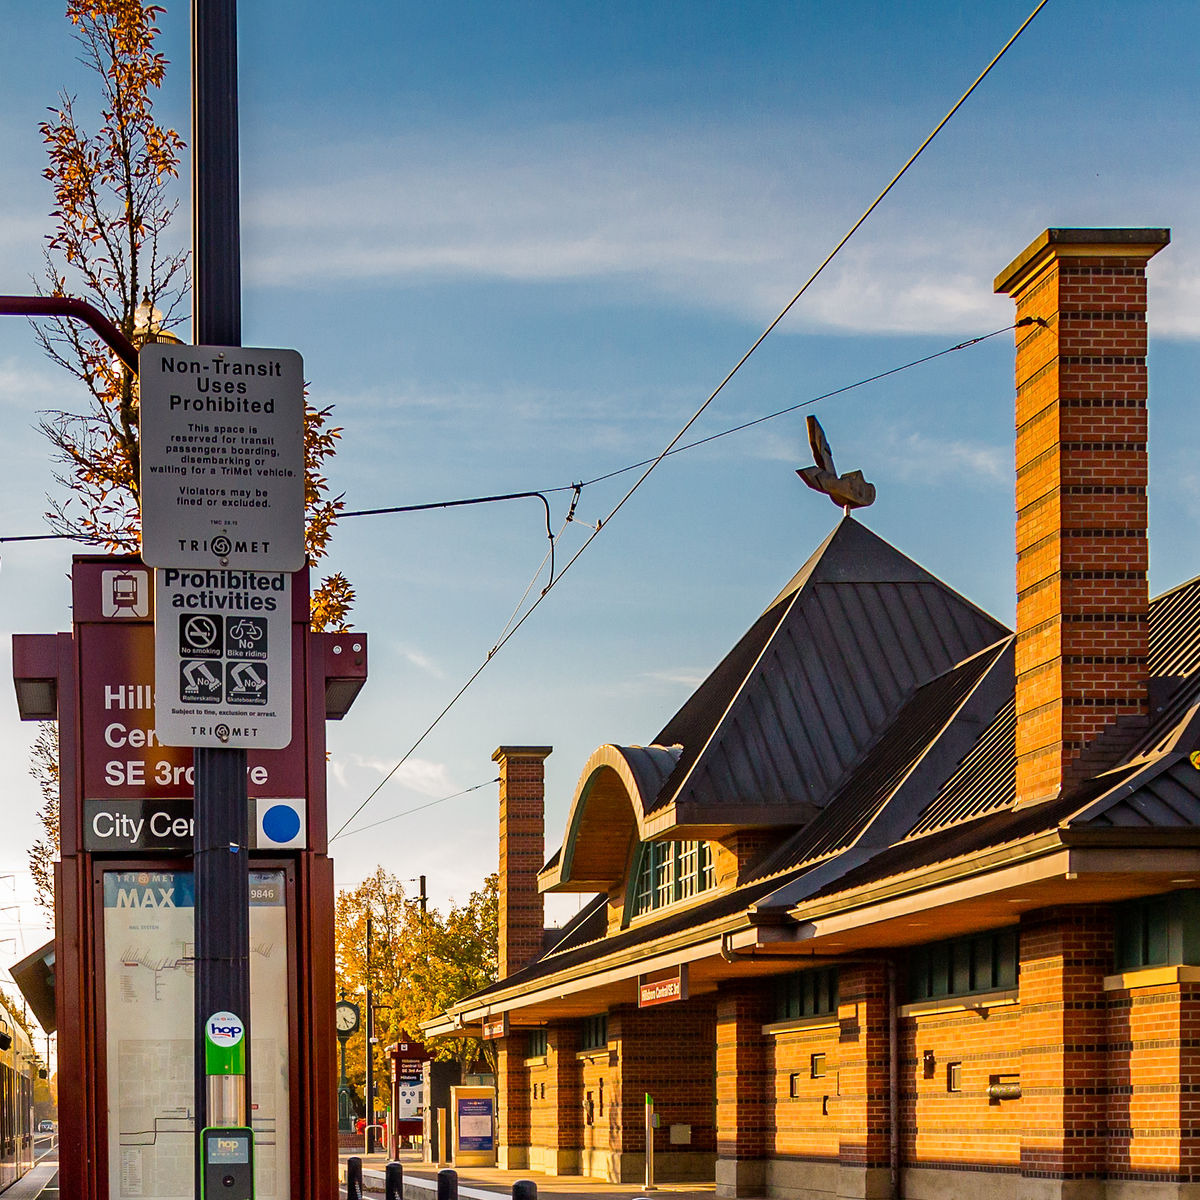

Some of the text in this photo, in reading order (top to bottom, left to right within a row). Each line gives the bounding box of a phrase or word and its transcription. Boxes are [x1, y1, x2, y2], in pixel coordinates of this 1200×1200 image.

[161, 357, 281, 377] Non-Transit
[197, 377, 247, 394] Uses
[170, 395, 275, 414] Prohibited
[188, 424, 258, 436] This space is
[171, 434, 274, 445] reserved for transit
[166, 445, 280, 457] passengers boarding,
[181, 455, 265, 467] disembarking or
[150, 465, 187, 476] waiting
[191, 466, 206, 474] for
[221, 467, 253, 476] TriMet
[257, 468, 296, 477] vehicle.
[179, 486, 268, 498] Violators may be
[177, 497, 203, 506] fined
[222, 498, 271, 508] excluded.
[164, 569, 285, 591] Prohibited
[172, 591, 277, 611] activities
[239, 640, 254, 649] No
[192, 648, 221, 656] smoking
[245, 651, 267, 659] riding
[197, 677, 209, 686] No
[244, 679, 257, 687] No
[104, 685, 156, 710] Hill
[171, 708, 195, 716] Subject
[105, 761, 145, 786] SE
[92, 812, 144, 843] City
[116, 888, 177, 909] MAX
[250, 889, 274, 899] 9846
[211, 1023, 242, 1038] hop
[217, 1138, 239, 1152] hop
